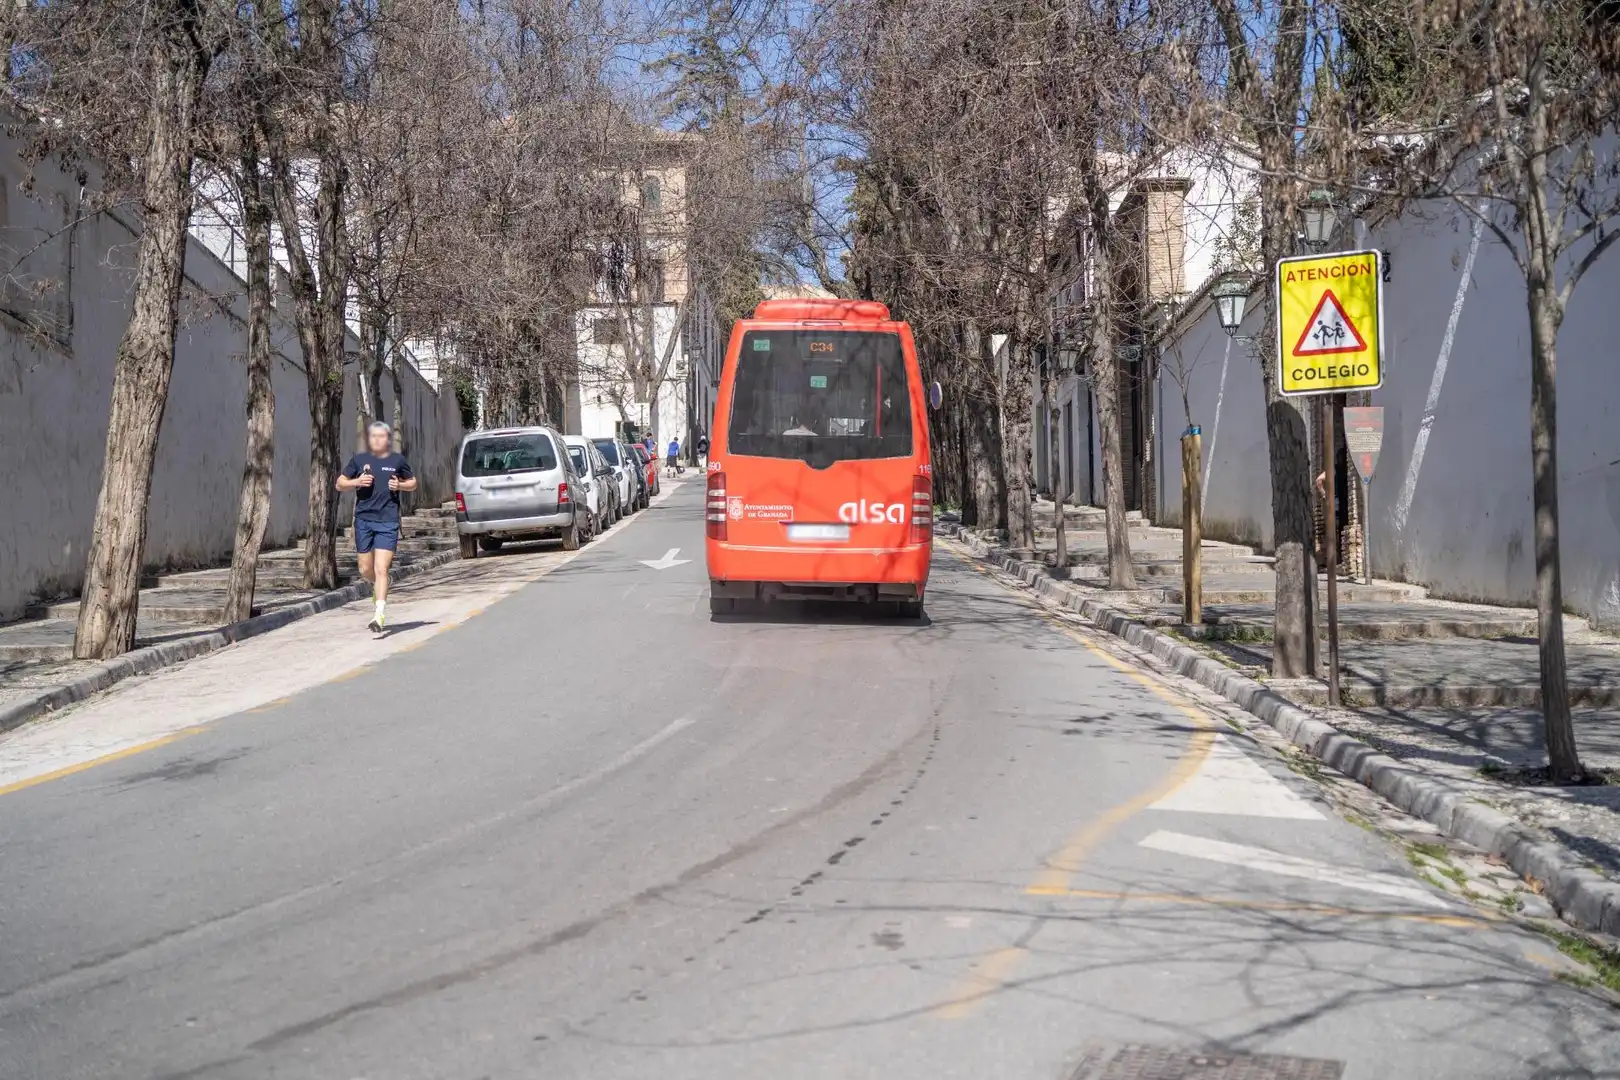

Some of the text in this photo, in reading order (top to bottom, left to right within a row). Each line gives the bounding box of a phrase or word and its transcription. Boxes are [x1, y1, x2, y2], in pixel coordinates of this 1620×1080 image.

[1286, 262, 1371, 282] ATENCIÓN
[810, 342, 834, 352] C34
[1292, 364, 1369, 381] COLEGIO
[838, 498, 905, 524] alsa
